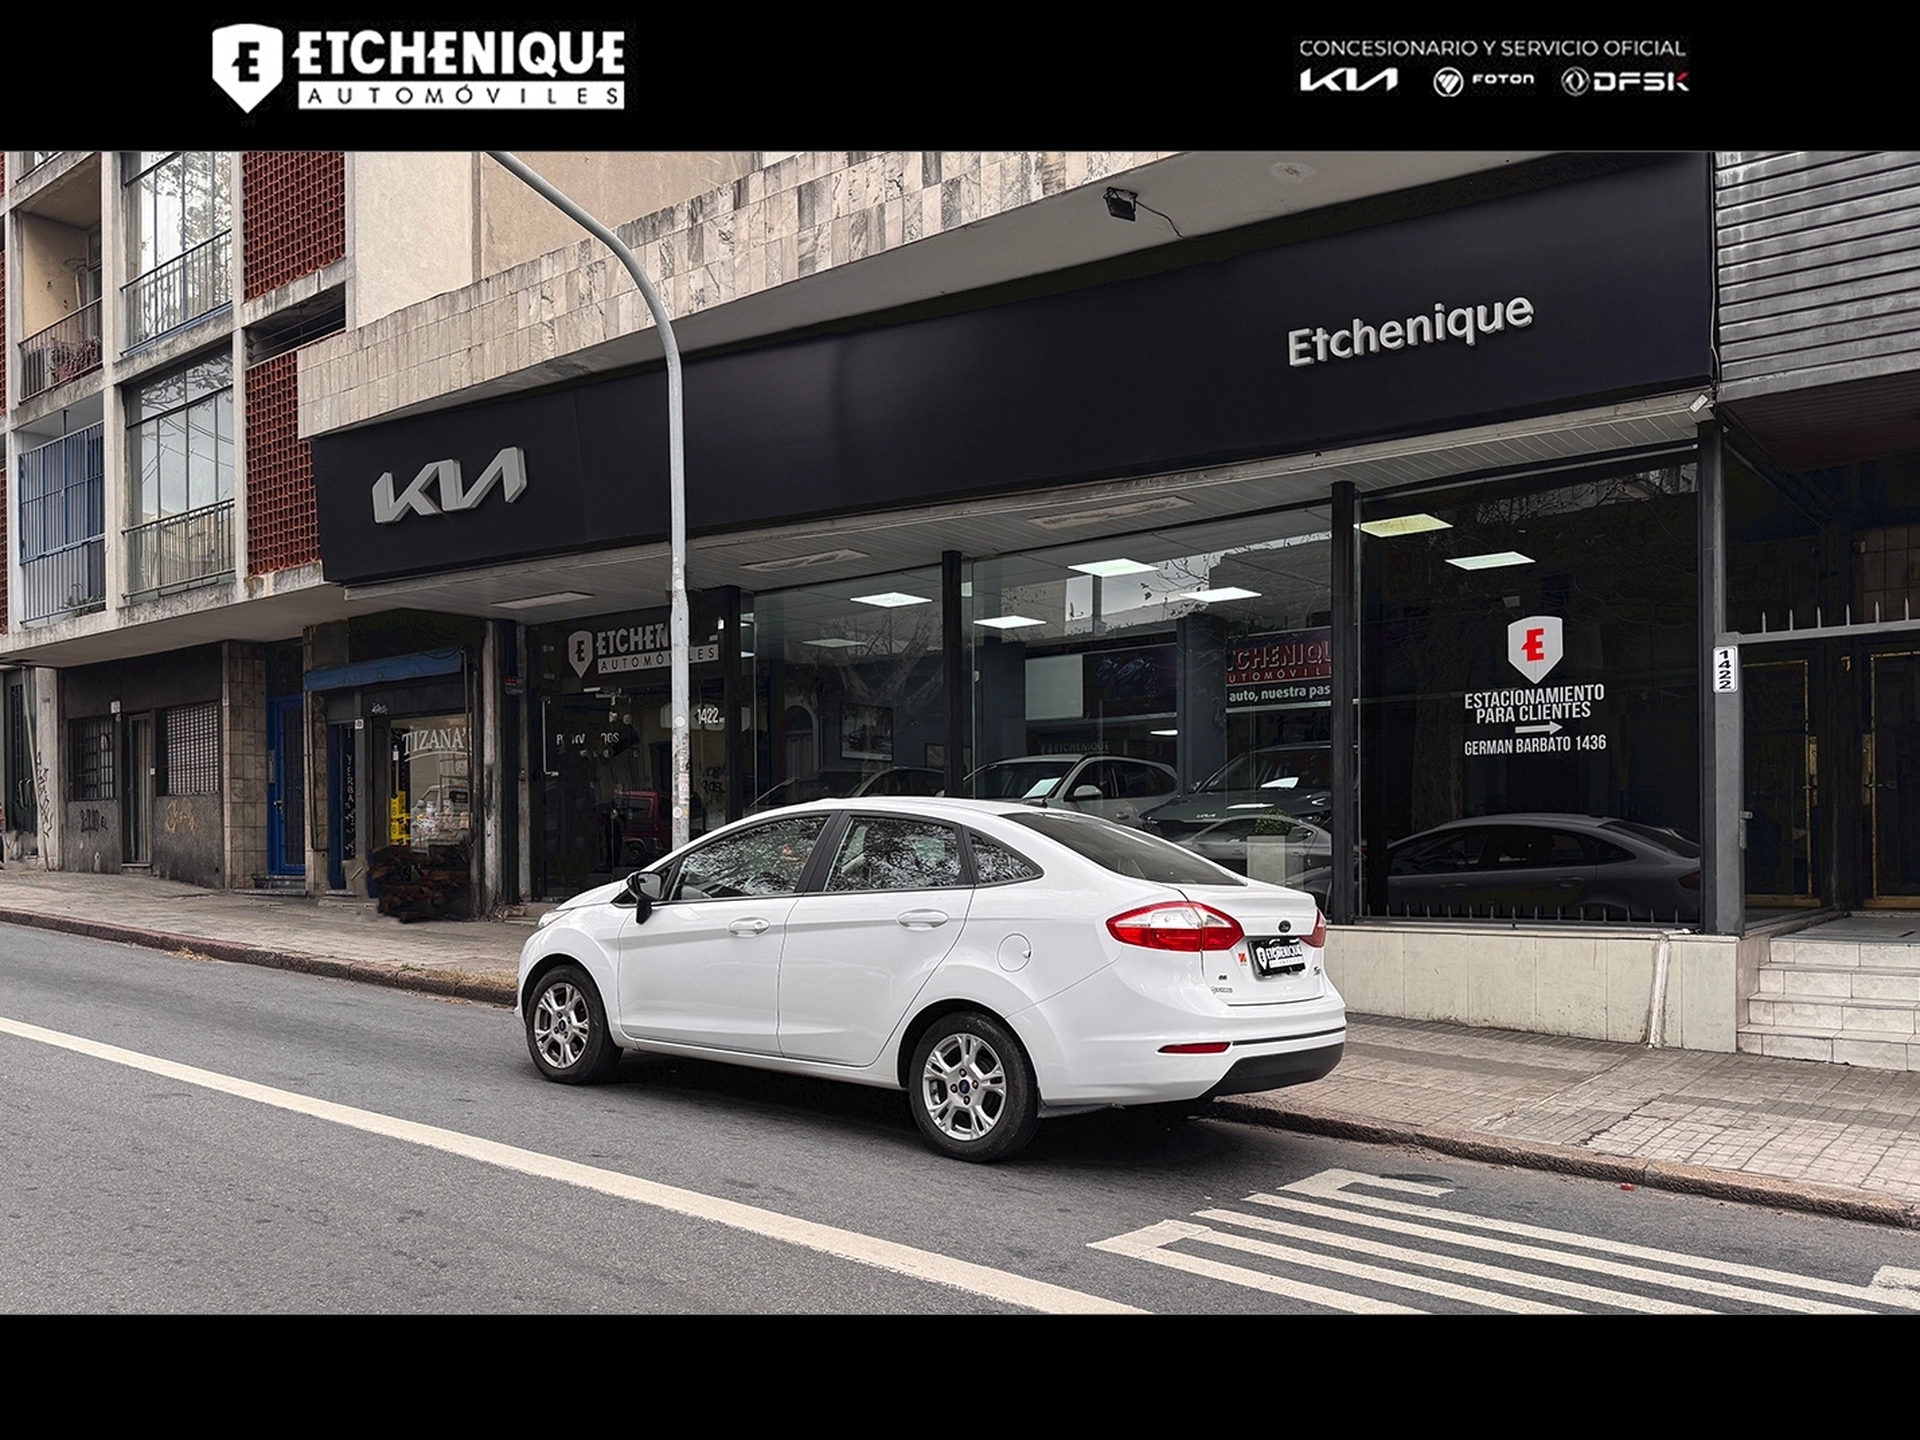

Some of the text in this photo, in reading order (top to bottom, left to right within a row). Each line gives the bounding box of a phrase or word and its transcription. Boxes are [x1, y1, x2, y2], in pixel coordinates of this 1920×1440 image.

[1288, 296, 1534, 367] Etchenique
[372, 446, 527, 523] KIA
[596, 623, 670, 656] ETCHEN
[1718, 650, 1732, 690] 1422
[1229, 684, 1332, 703] auto, nuestra pas
[1464, 683, 1605, 709] ESTACIONAMIENTO
[697, 707, 719, 724] 1422
[1476, 701, 1592, 724] PARA CLIENTES
[402, 727, 467, 756] TIZANA'
[1464, 734, 1607, 756] GERMAN BARBATO 1436
